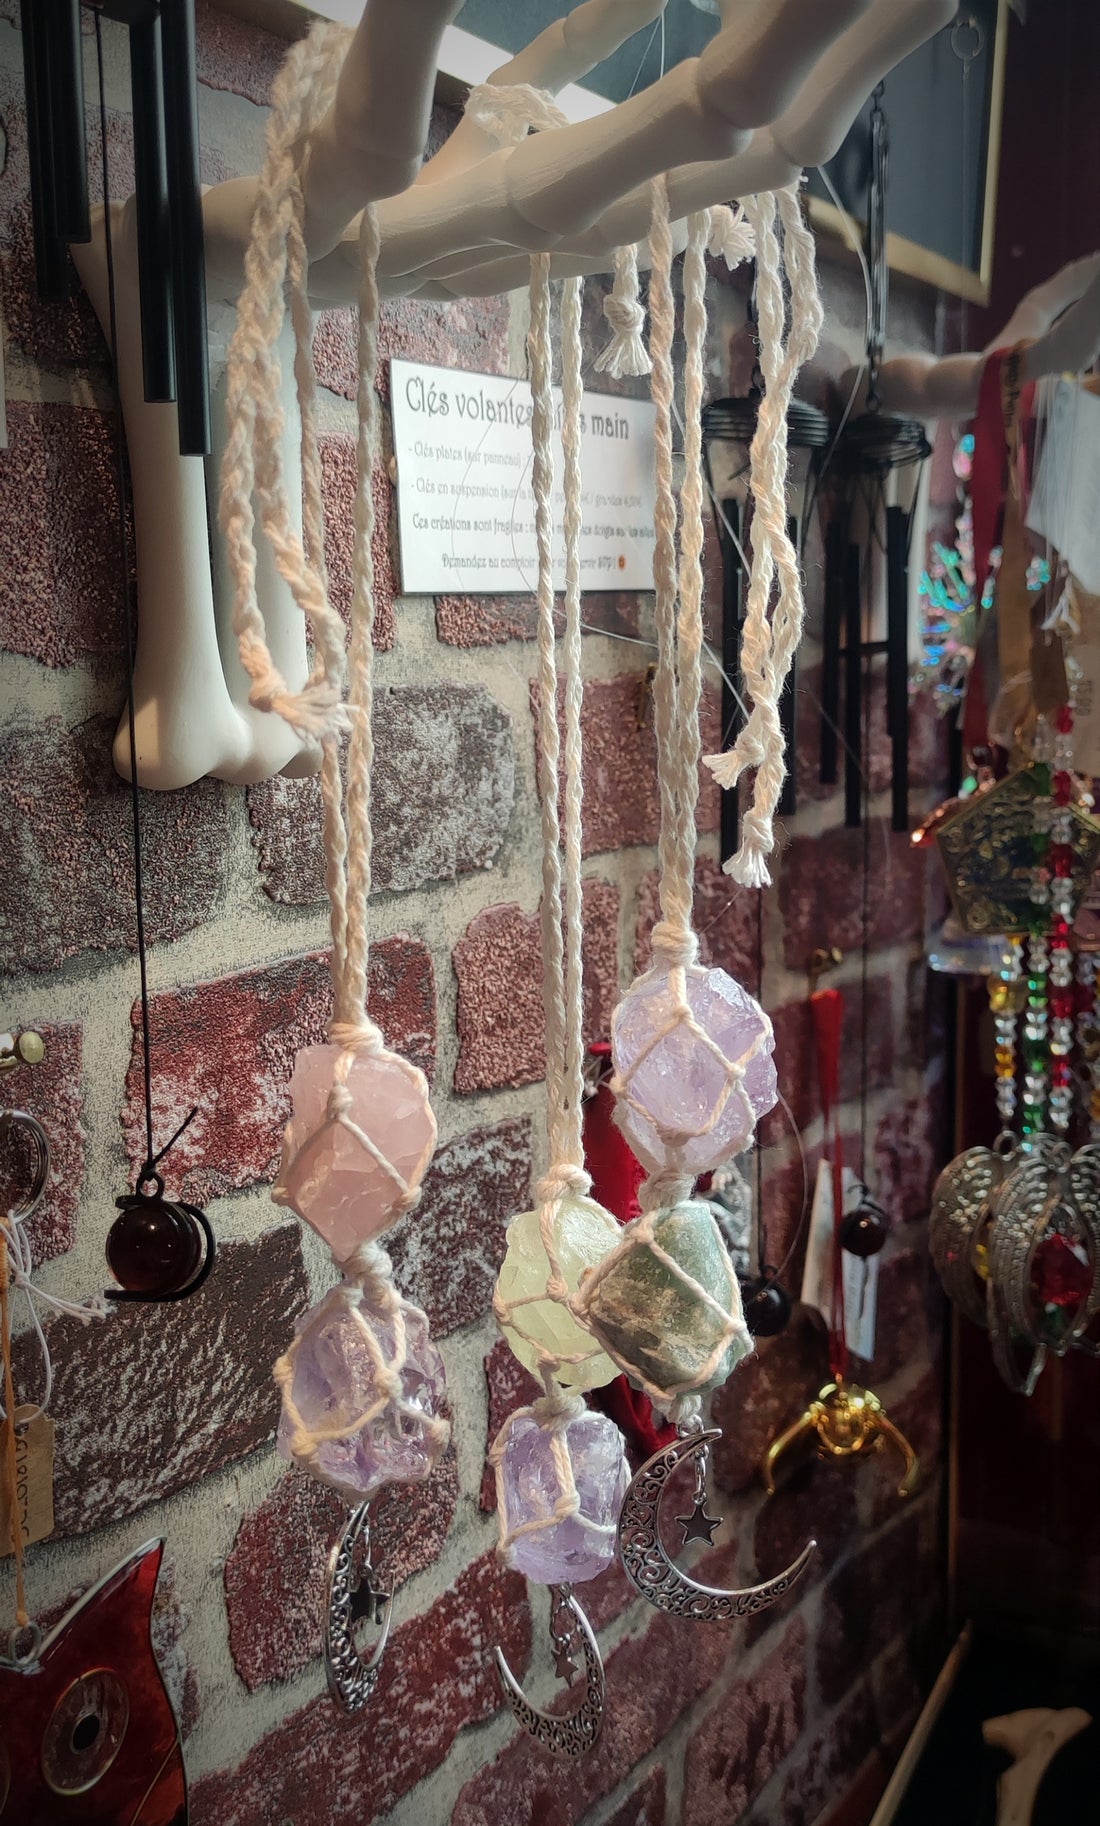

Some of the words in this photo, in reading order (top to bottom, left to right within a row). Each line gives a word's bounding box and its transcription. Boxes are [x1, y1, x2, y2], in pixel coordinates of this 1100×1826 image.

[405, 376, 449, 418] Clés
[455, 389, 533, 429] volantes
[591, 412, 629, 440] main
[414, 441, 434, 459] Clés
[416, 477, 436, 494] Clés
[437, 483, 449, 495] en
[412, 513, 429, 529] Ces
[473, 519, 492, 532] sont
[441, 552, 487, 569] Demandez
[488, 556, 500, 568] au
